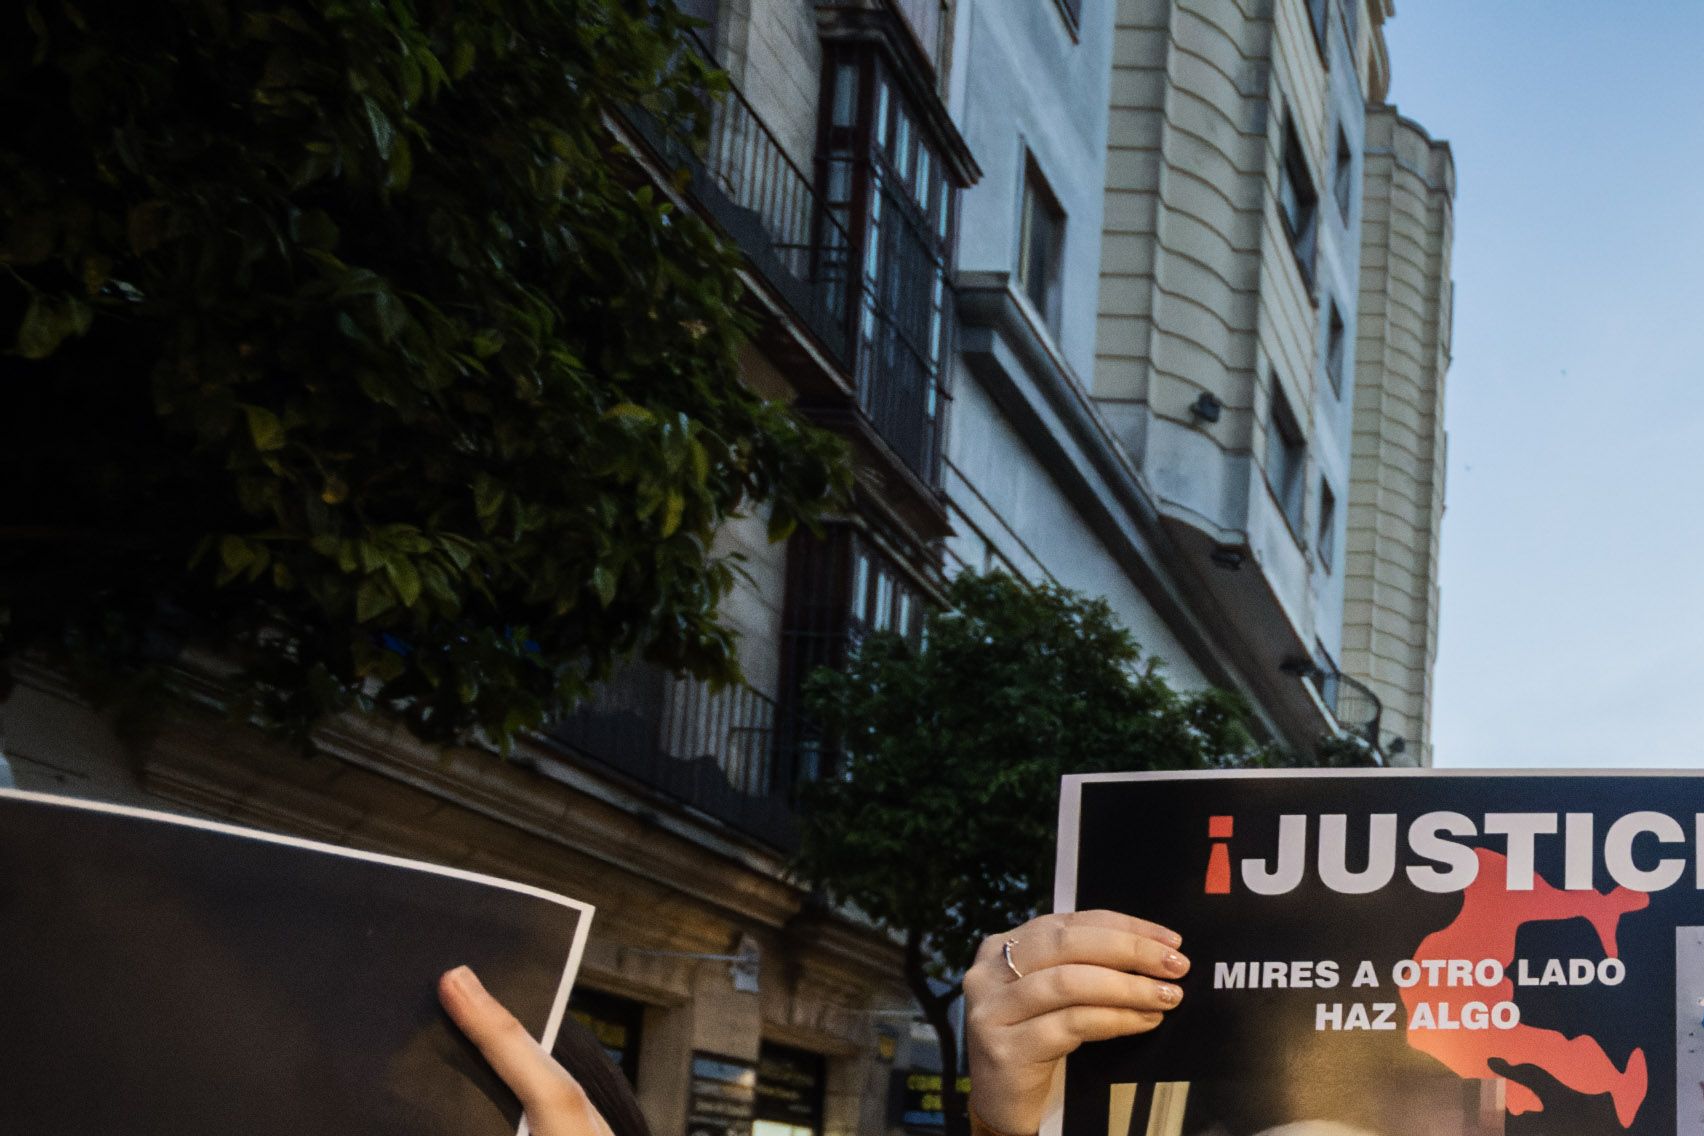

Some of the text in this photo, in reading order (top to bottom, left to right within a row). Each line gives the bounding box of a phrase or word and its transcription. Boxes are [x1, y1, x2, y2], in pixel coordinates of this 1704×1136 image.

[1213, 958, 1627, 989] MIRES A OTRO LADO
[1315, 1001, 1521, 1030] HAZ ALGO
